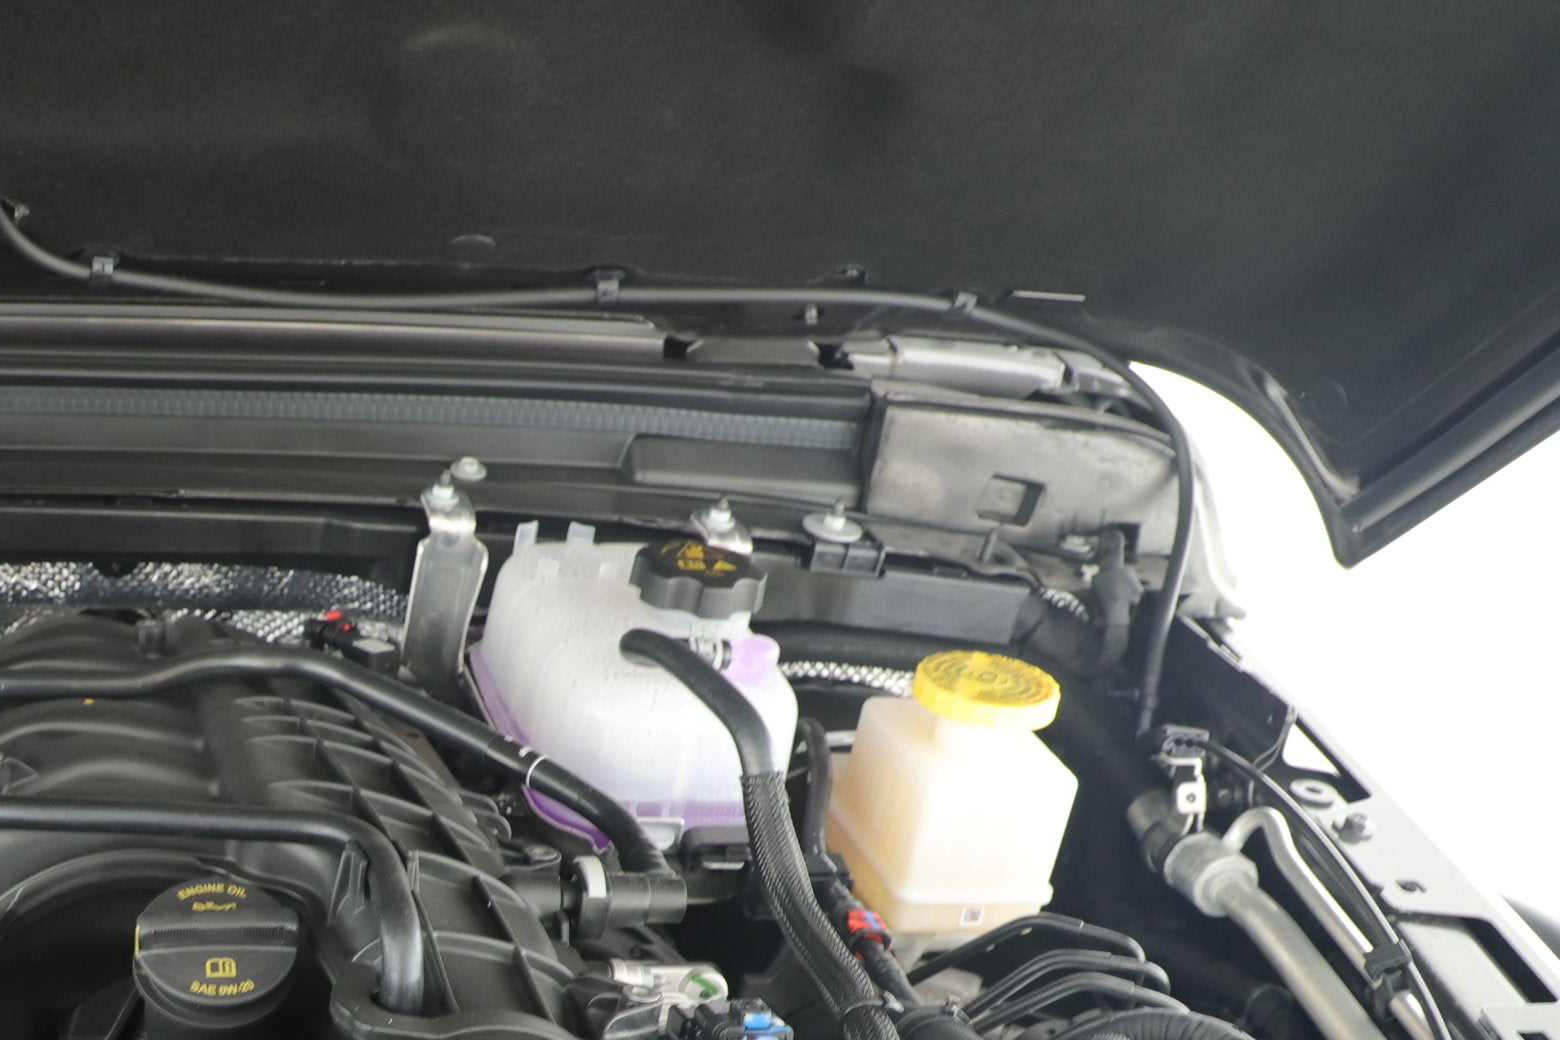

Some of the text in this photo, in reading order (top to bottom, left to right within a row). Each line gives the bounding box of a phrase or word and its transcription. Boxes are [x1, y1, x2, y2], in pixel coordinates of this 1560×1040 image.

[177, 883, 246, 900] ENGINE OIL
[190, 980, 254, 996] SAE 0W-20
